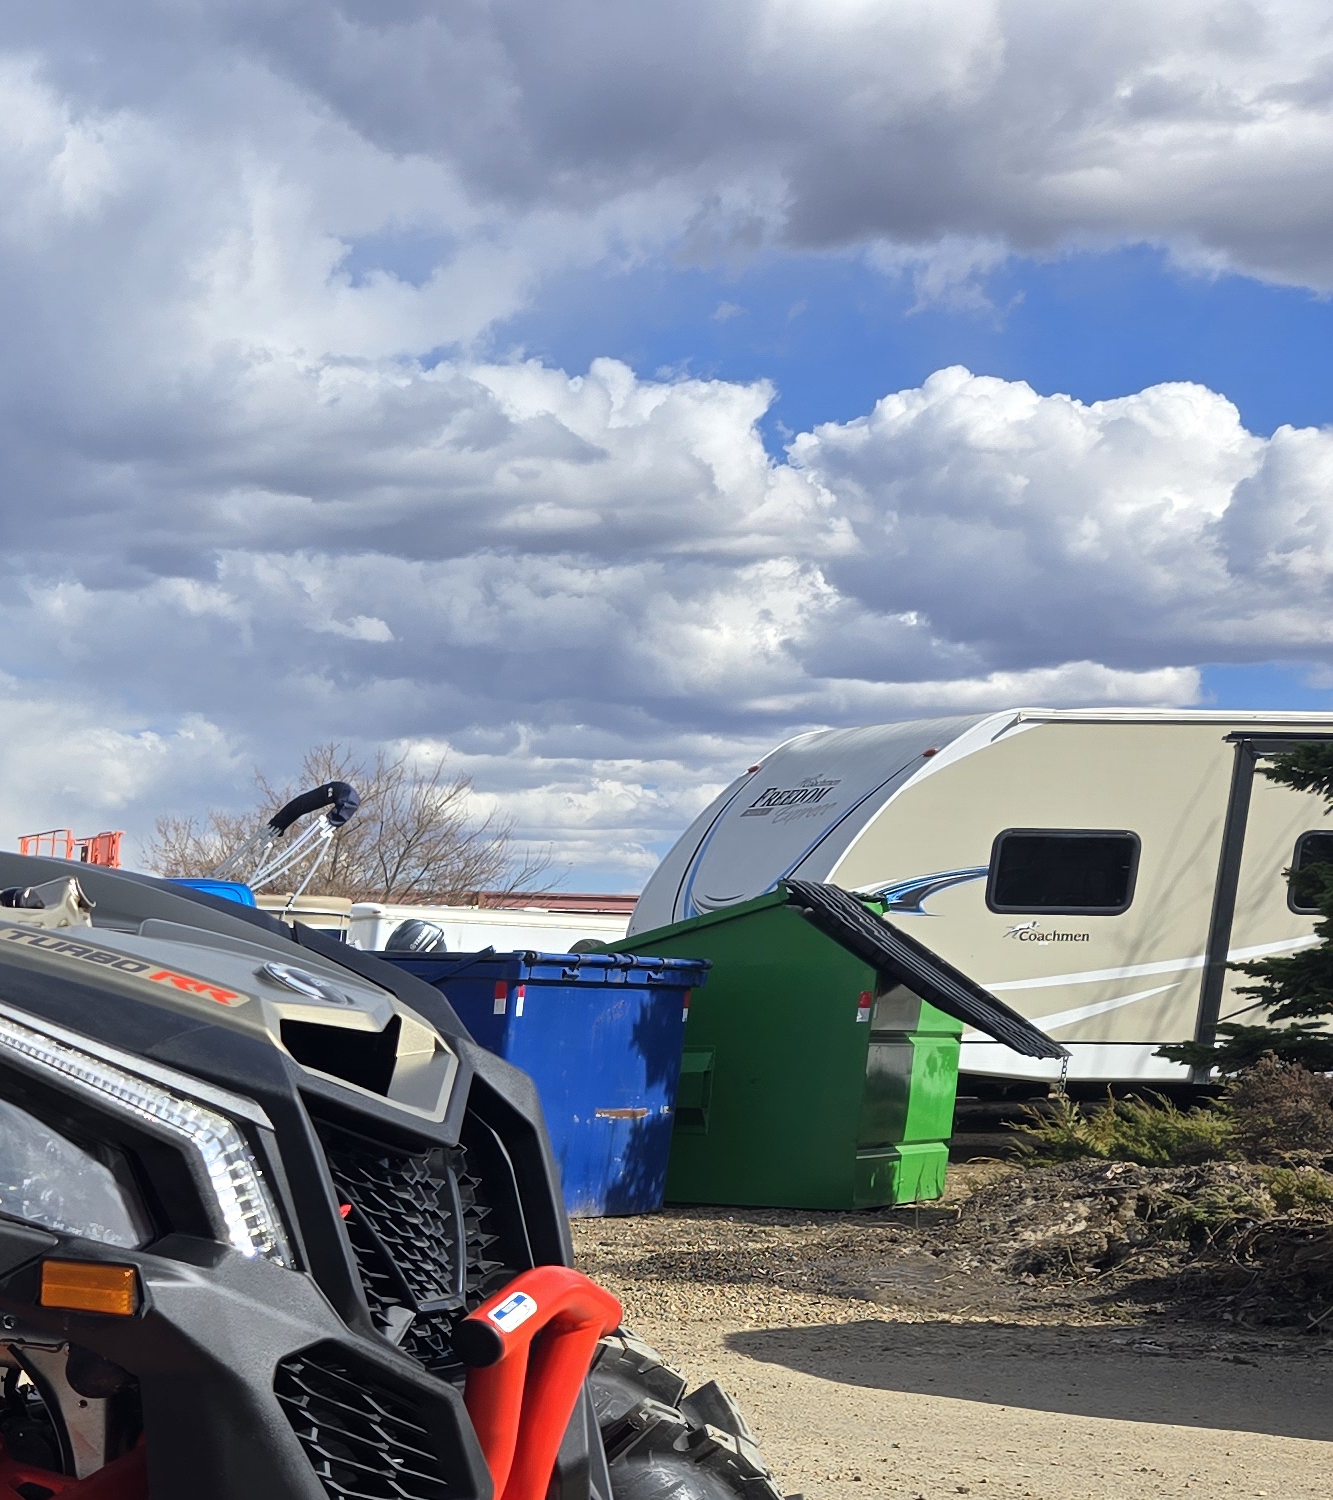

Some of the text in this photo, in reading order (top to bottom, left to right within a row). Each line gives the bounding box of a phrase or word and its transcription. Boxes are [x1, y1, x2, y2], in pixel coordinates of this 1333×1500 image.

[748, 787, 834, 808] FREEDOM
[1019, 930, 1090, 942] Coachmen
[7, 929, 239, 1006] TURBO RR
